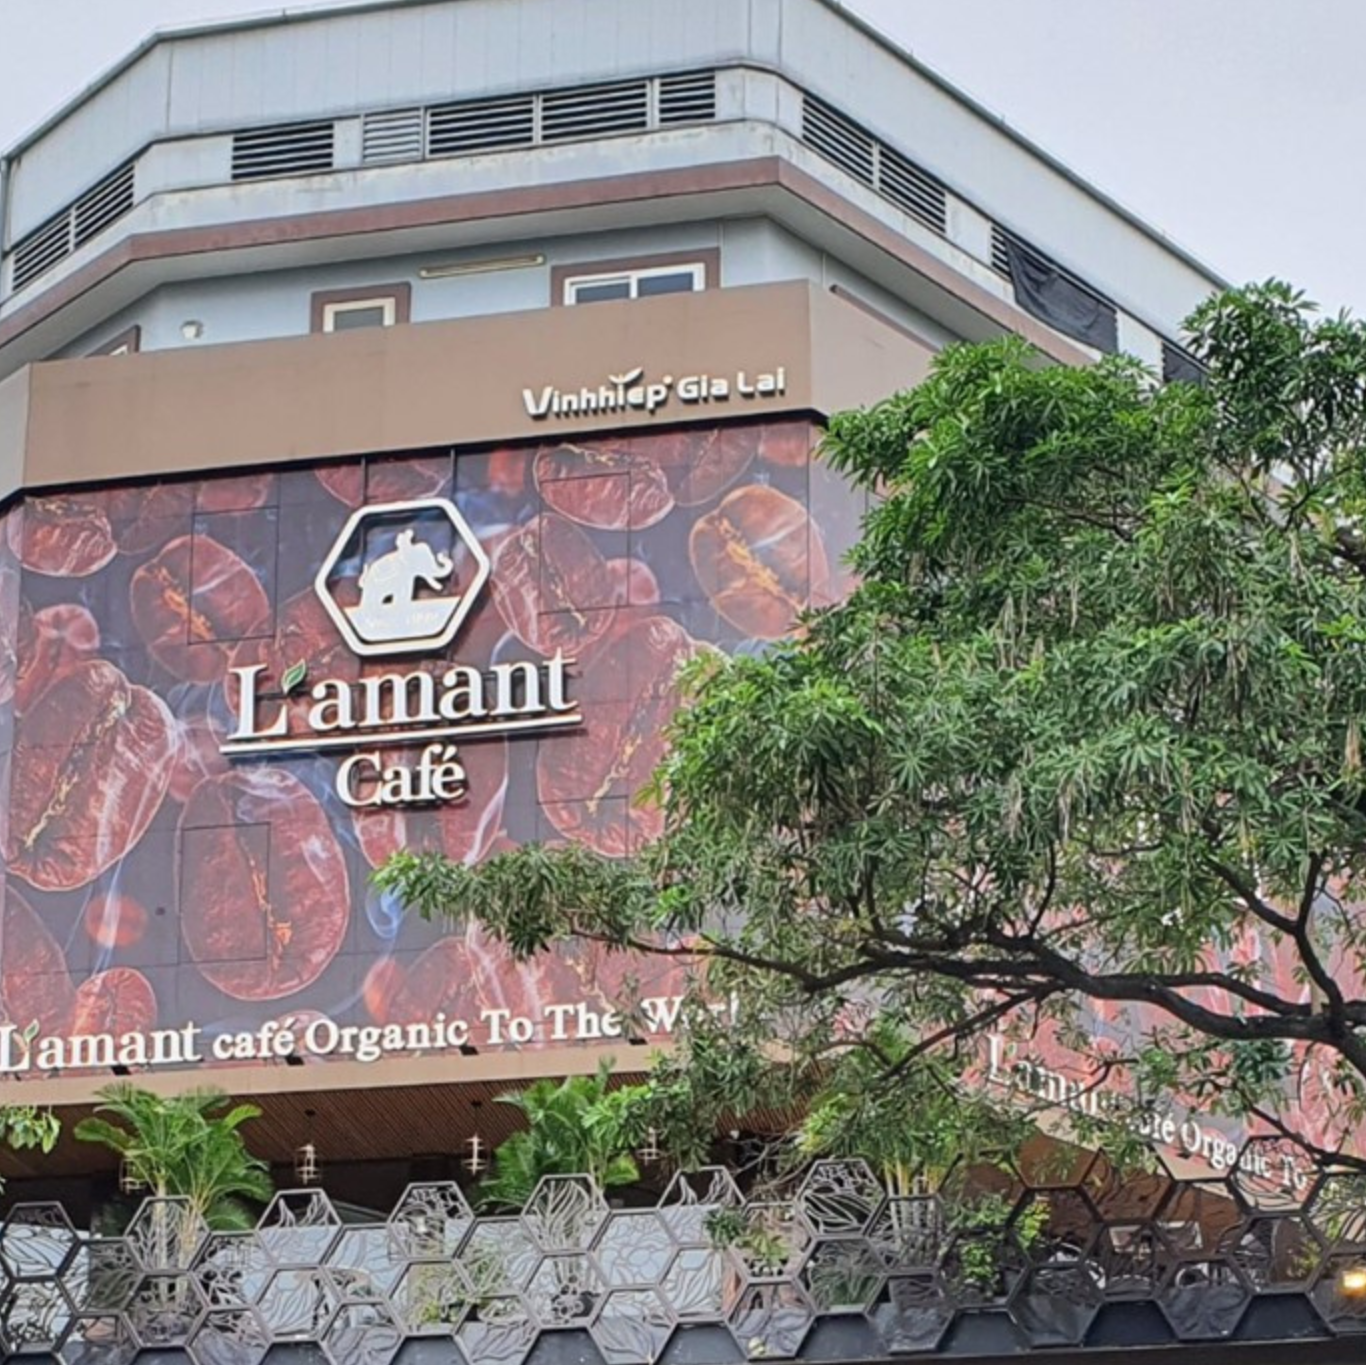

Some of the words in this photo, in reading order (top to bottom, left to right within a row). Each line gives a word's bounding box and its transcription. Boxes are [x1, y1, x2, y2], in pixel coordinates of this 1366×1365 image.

[677, 374, 728, 401] Gia
[737, 367, 785, 394] Lai
[227, 647, 579, 740] L'amant
[335, 743, 466, 806] Café
[212, 1016, 296, 1058] café
[304, 1012, 469, 1062] Organic
[481, 1008, 534, 1045] To
[544, 1001, 623, 1040] The
